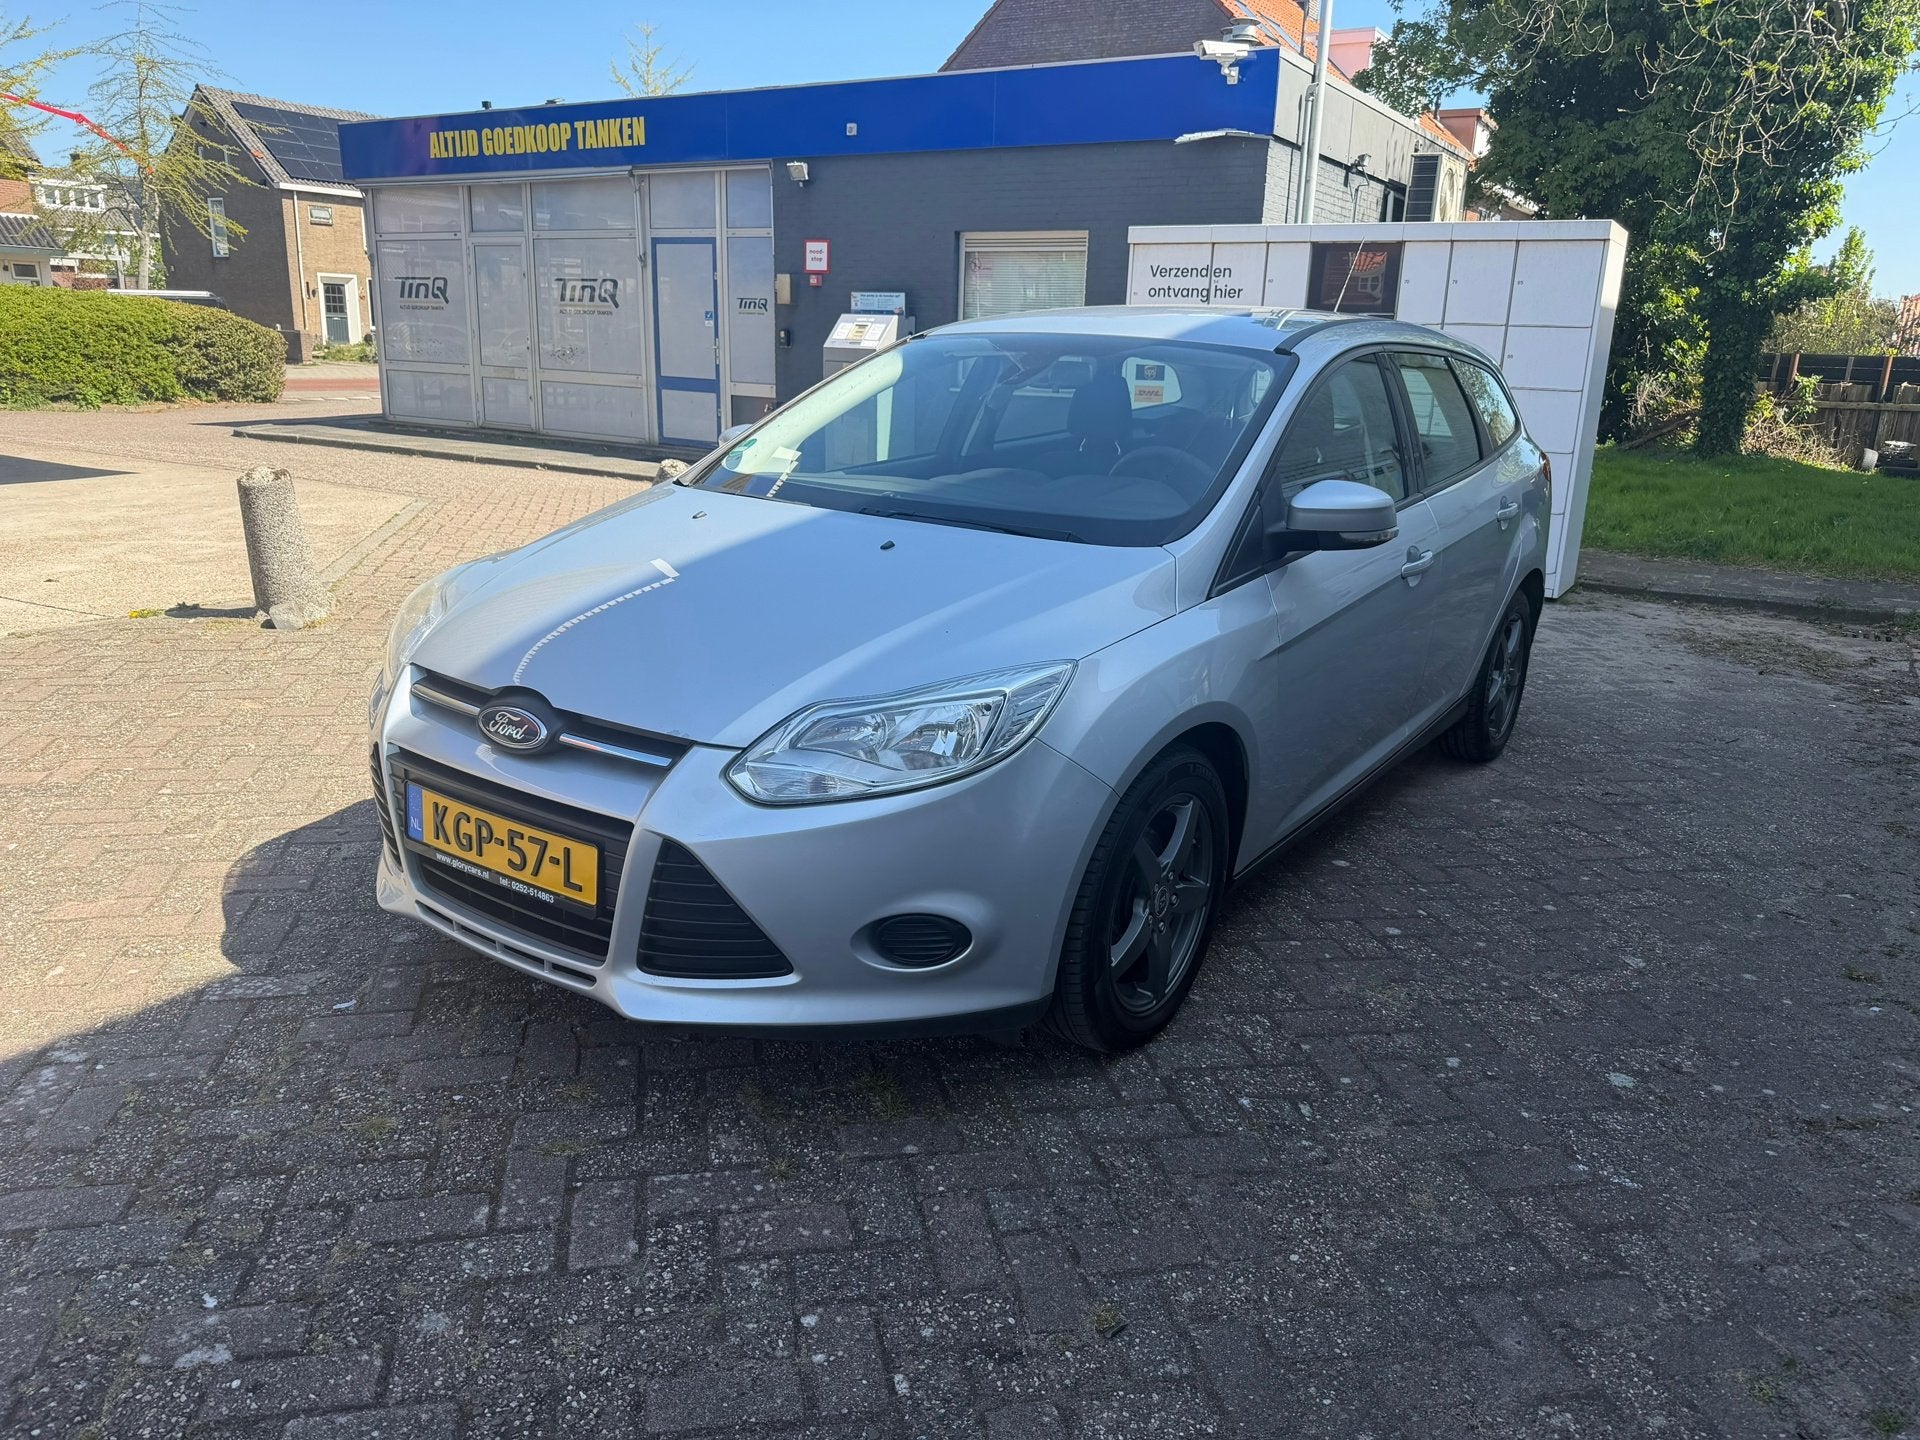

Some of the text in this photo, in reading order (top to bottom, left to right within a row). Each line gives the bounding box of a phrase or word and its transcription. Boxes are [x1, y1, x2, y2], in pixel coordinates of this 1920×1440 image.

[429, 116, 646, 159] ALTIJD GOEDKOOP TANKEN
[1150, 264, 1232, 278] Verzend en
[394, 276, 450, 304] TinQ
[554, 278, 620, 309] TinQ
[1148, 284, 1243, 302] ontvang hier
[736, 297, 768, 312] TinQ
[488, 711, 529, 740] Ford
[410, 817, 422, 831] NL
[431, 801, 583, 893] KGP-57-L
[436, 852, 555, 904] www.glorycars.nl tel: 0252-514863
